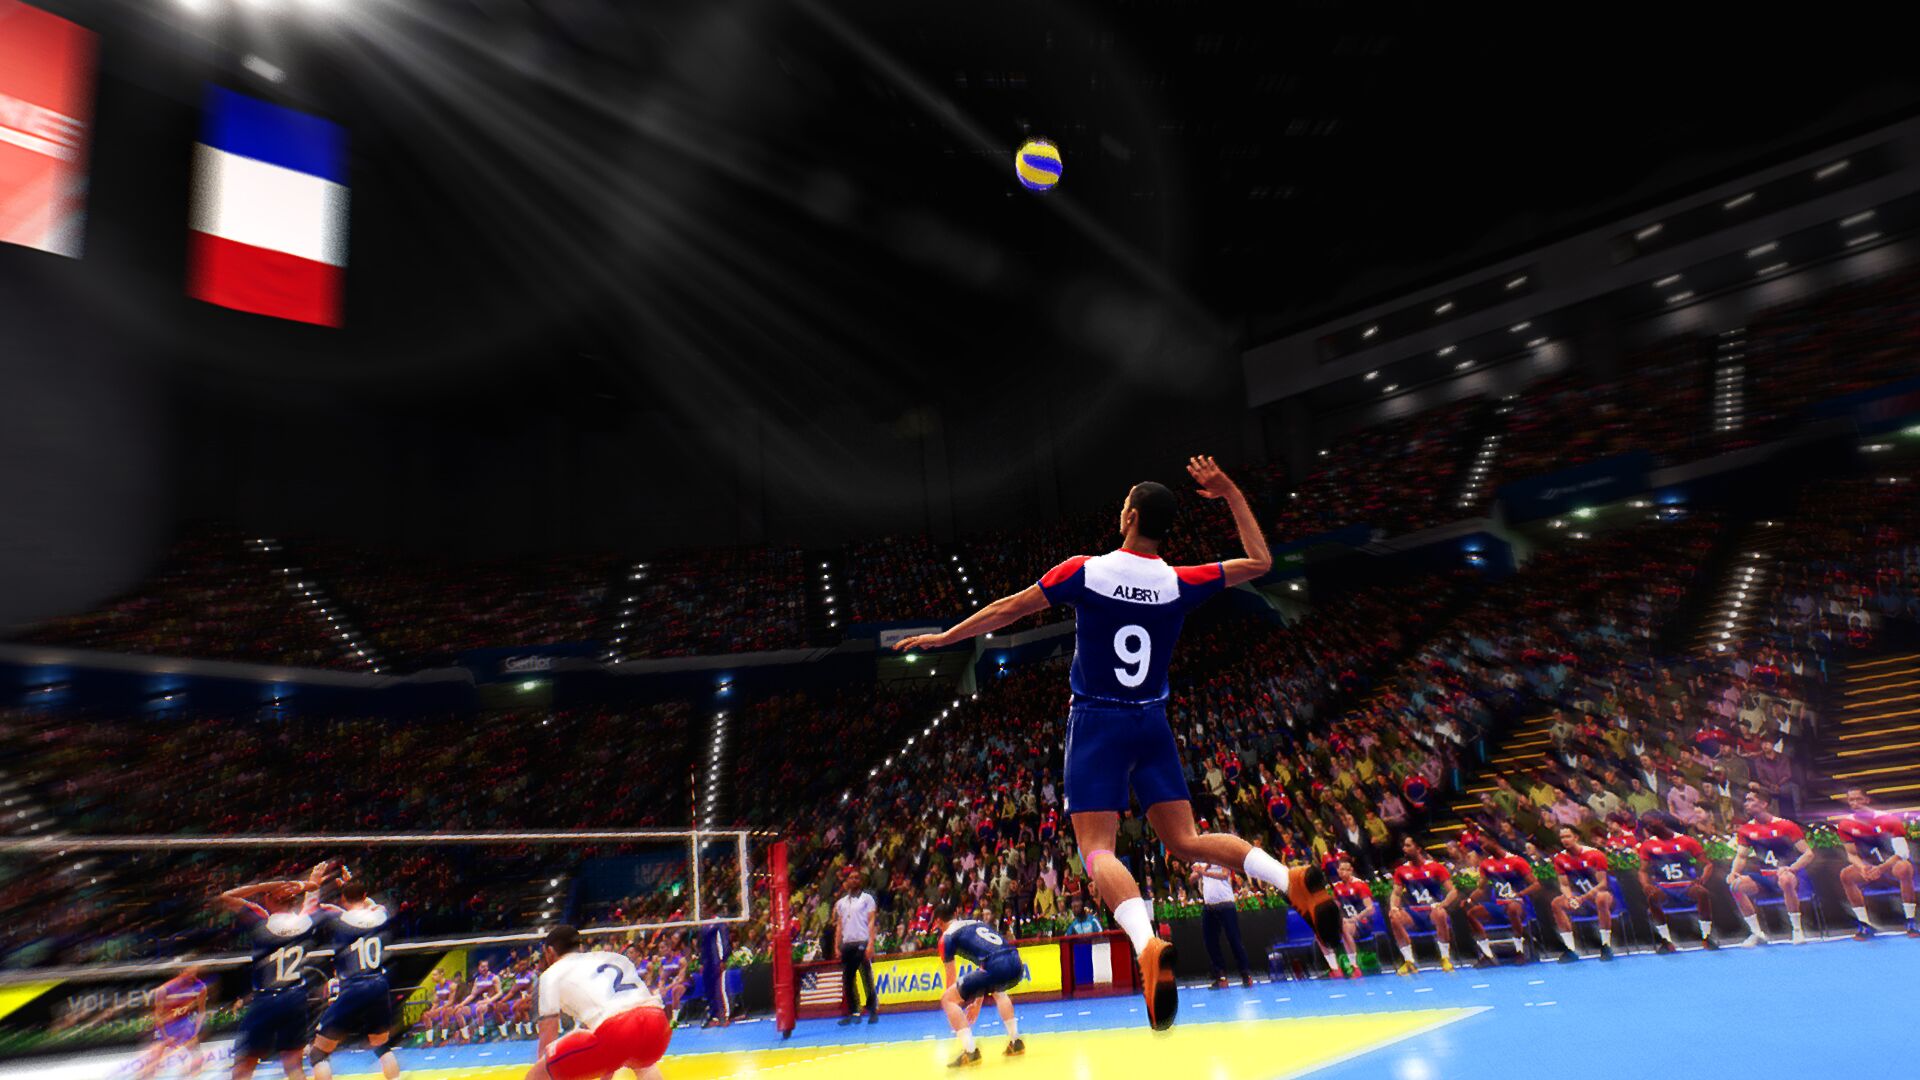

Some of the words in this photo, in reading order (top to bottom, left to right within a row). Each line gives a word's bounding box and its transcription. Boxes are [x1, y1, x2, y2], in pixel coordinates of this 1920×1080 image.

[1113, 585, 1161, 602] AUBRY
[1113, 624, 1152, 688] 9
[1764, 850, 1778, 867] 4
[1661, 863, 1684, 880] 15
[1576, 877, 1595, 893] 11
[1412, 888, 1433, 904] 14
[975, 926, 1003, 946] 6
[350, 936, 382, 970] 10
[269, 945, 304, 982] 12
[596, 963, 638, 993] 2
[67, 987, 155, 1013] VOLLEY
